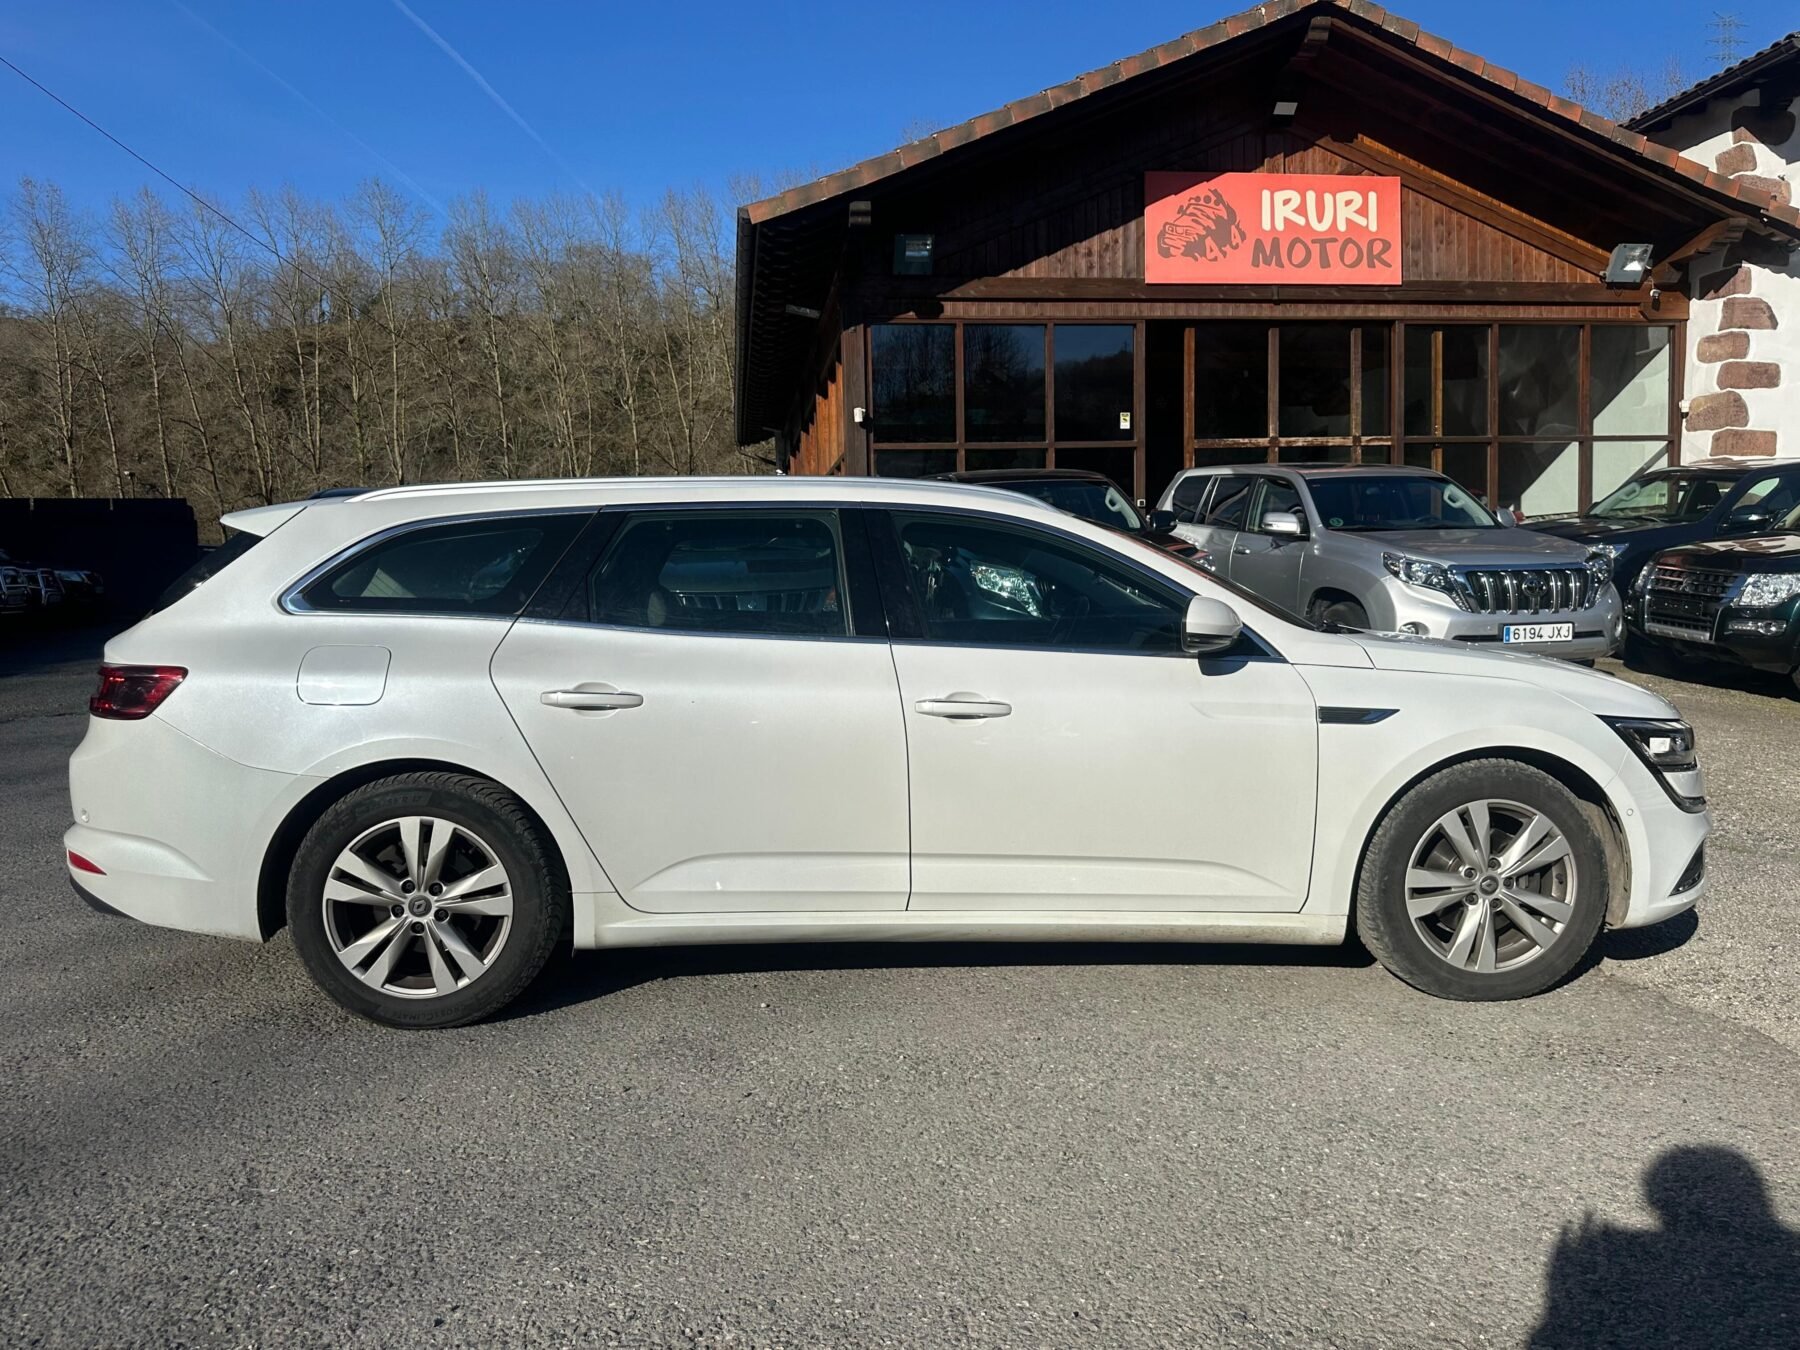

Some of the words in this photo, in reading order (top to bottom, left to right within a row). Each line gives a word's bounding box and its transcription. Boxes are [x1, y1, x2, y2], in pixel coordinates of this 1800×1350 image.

[1261, 189, 1378, 232] IRURI
[1251, 236, 1393, 269] MOTOR
[1513, 627, 1543, 640] 6194
[1548, 626, 1571, 639] JXJ
